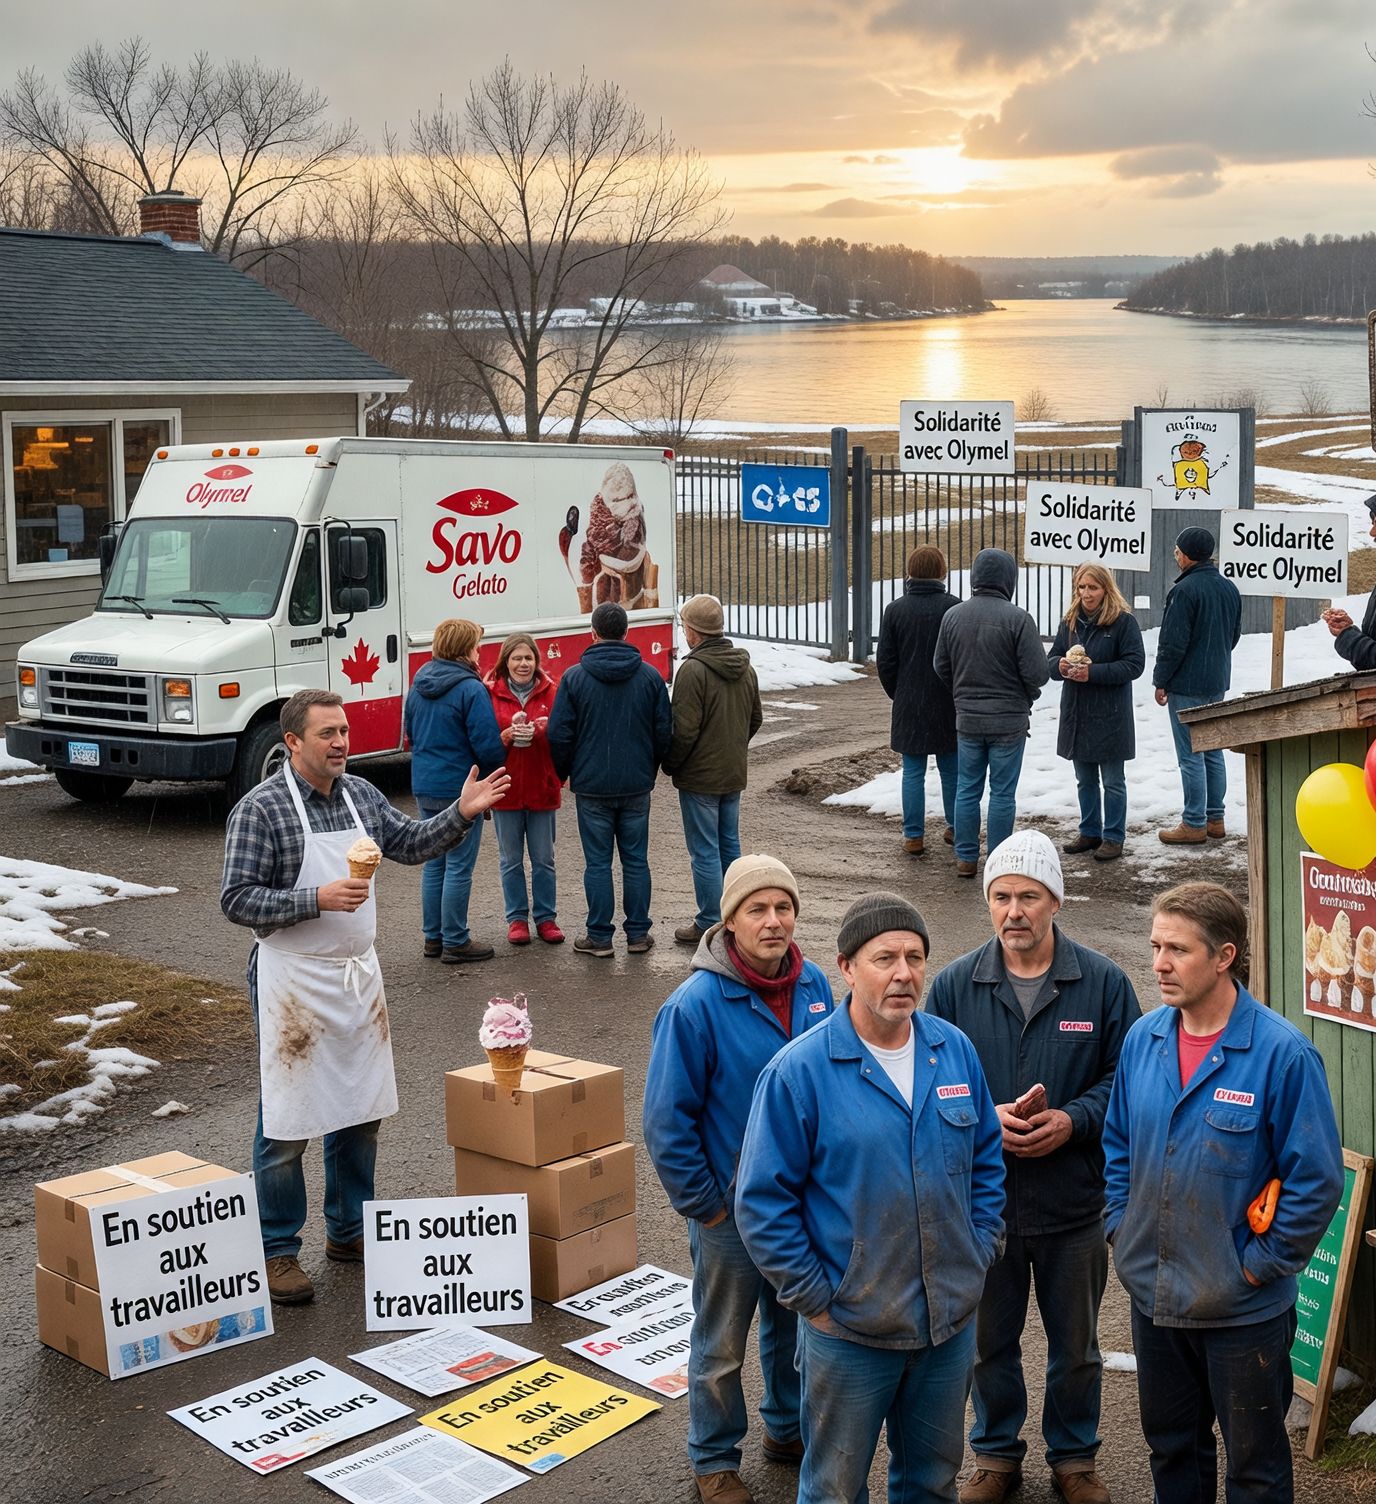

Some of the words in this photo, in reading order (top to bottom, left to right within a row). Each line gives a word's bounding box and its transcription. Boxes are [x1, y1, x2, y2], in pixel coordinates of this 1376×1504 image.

[914, 410, 1001, 432] Solidarité
[904, 445, 943, 460] avec
[947, 439, 1009, 466] Olymel
[186, 482, 253, 509] Olymel
[1040, 494, 1136, 523] Solidarité
[426, 517, 522, 574] Savo
[1030, 531, 1072, 550] avec
[1077, 528, 1145, 559] Olymel
[1232, 522, 1334, 550] Solidarité
[452, 571, 507, 600] Gelato
[1223, 562, 1268, 579] avec
[1272, 557, 1342, 589] Olymel
[102, 1211, 140, 1247] En
[147, 1190, 246, 1238] soutien
[375, 1210, 410, 1242] En
[418, 1206, 517, 1239] soutien
[159, 1242, 209, 1275] aux
[423, 1253, 474, 1277] aux
[110, 1269, 261, 1328] travailleurs
[373, 1283, 525, 1318] travailleurs
[187, 1405, 233, 1423] En
[232, 1368, 326, 1409] soutien
[260, 1396, 313, 1421] aux
[437, 1409, 482, 1429] En
[479, 1371, 565, 1413] soutien
[515, 1401, 563, 1425] aux
